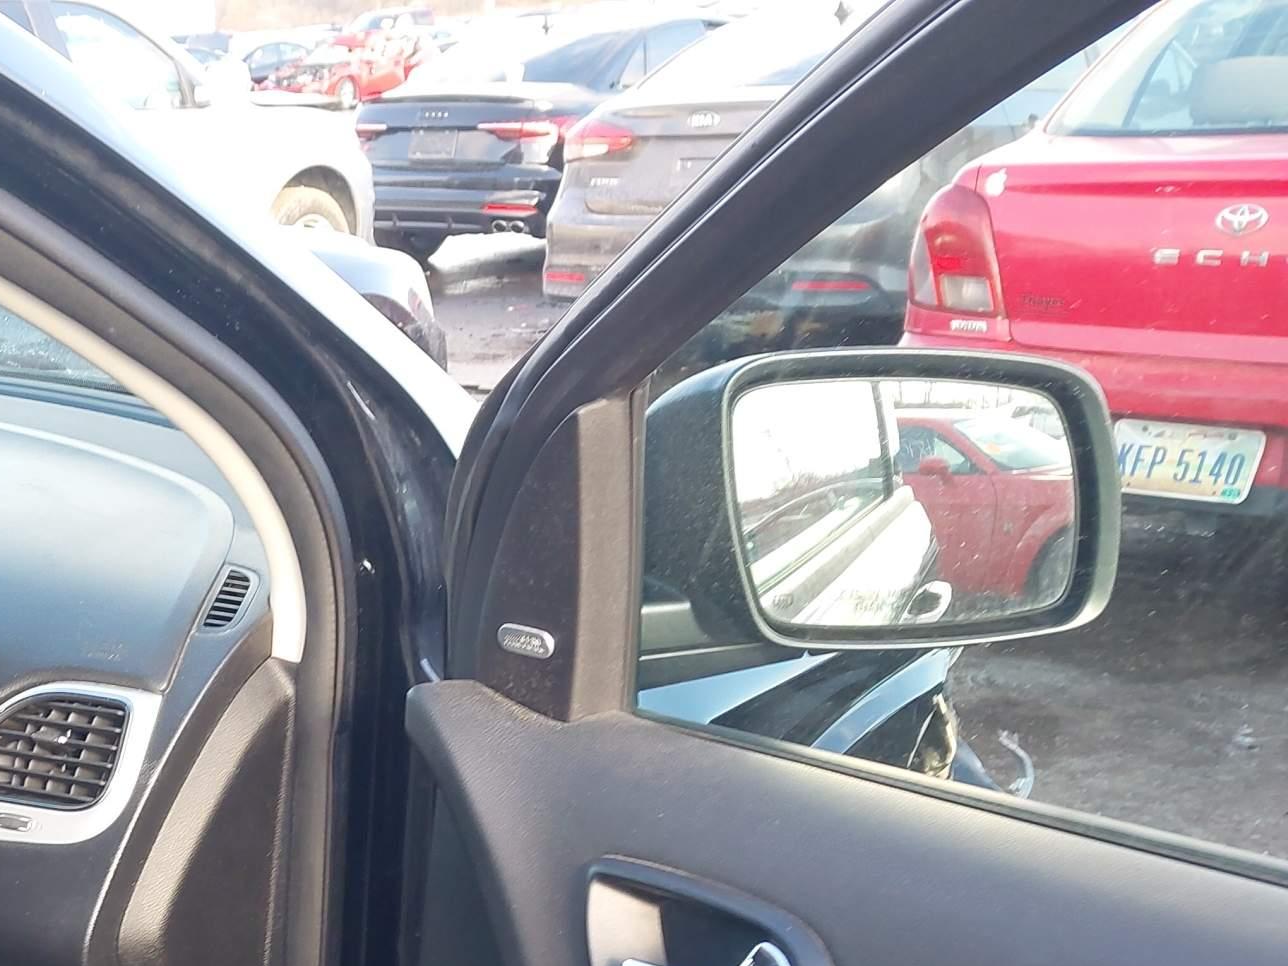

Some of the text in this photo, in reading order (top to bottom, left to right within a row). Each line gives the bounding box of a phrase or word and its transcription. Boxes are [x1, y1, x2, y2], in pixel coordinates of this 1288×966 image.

[1153, 247, 1288, 267] ECH
[1117, 442, 1246, 487] KFP 5140
